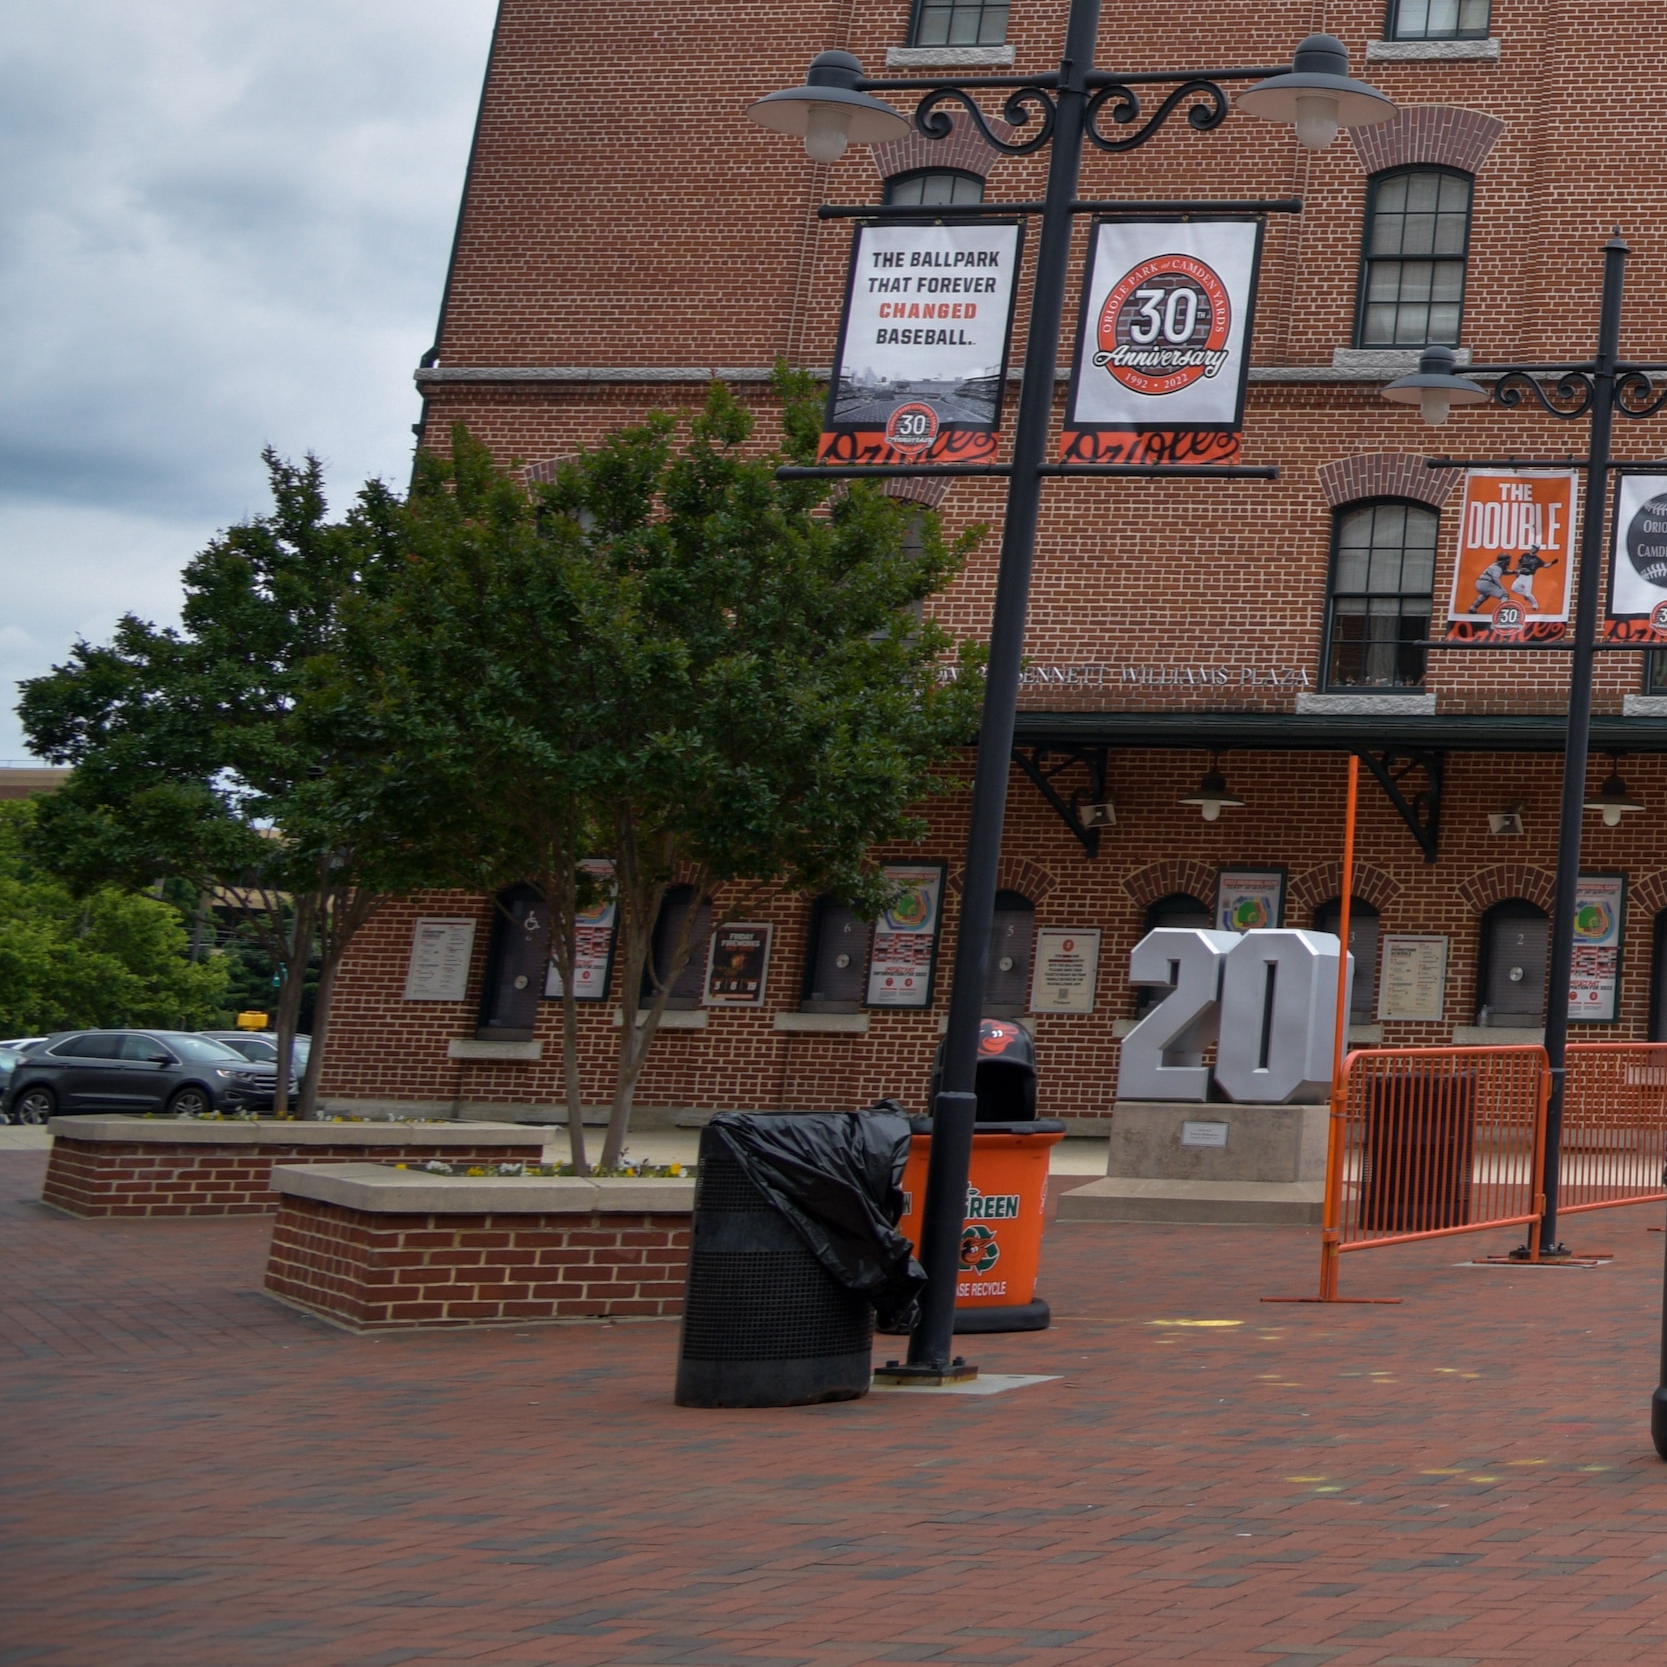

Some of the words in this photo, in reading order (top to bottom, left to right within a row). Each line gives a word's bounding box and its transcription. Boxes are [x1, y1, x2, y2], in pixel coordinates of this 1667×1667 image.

[873, 252, 904, 267] THE
[910, 251, 1000, 267] BALLPARK
[868, 277, 912, 293] THAT
[917, 277, 997, 293] FOREVER
[1103, 284, 1129, 333] ORIOLE
[1128, 263, 1158, 285] PARK
[1171, 259, 1217, 290] CAMDEN
[1213, 291, 1225, 333] YARDS
[879, 303, 977, 319] CHANGED
[1130, 288, 1198, 344] 30
[1093, 344, 1229, 378] Anniversary
[1125, 372, 1149, 389] 1992
[1164, 373, 1189, 389] 2022
[900, 415, 926, 434] 30
[1499, 483, 1532, 501] THE
[1467, 501, 1562, 550] DOUBLE
[1501, 609, 1518, 623] 30
[1517, 934, 1524, 945] 2
[1117, 927, 1355, 1103] 20
[971, 1282, 1006, 1296] RECYCLE
